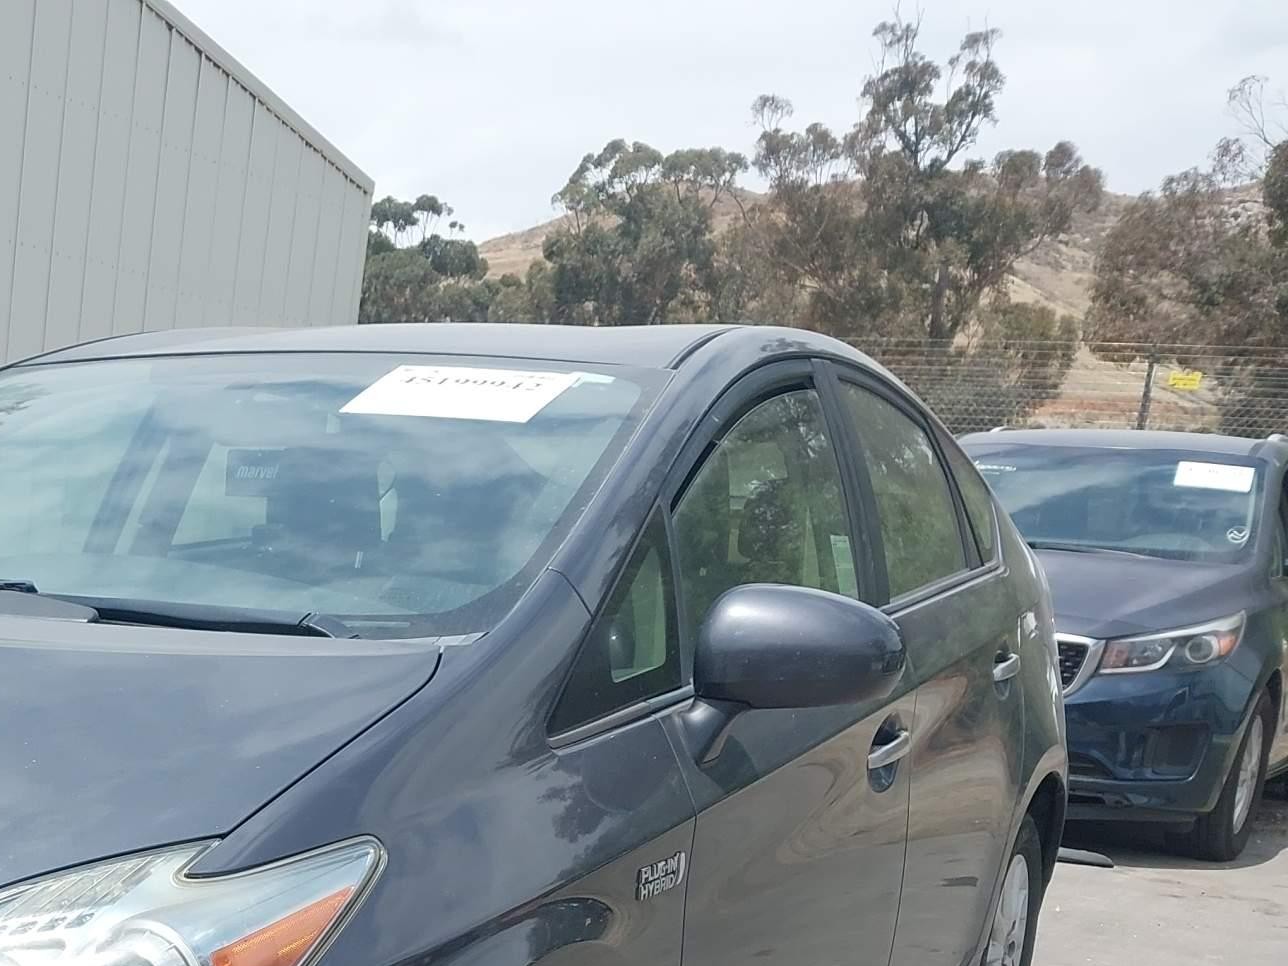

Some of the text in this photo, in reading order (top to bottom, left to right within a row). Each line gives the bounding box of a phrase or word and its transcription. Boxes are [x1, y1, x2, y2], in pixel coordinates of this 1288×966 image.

[237, 463, 280, 480] marvel
[639, 852, 680, 885] PLUG-IN
[640, 873, 677, 901] HYBRID
